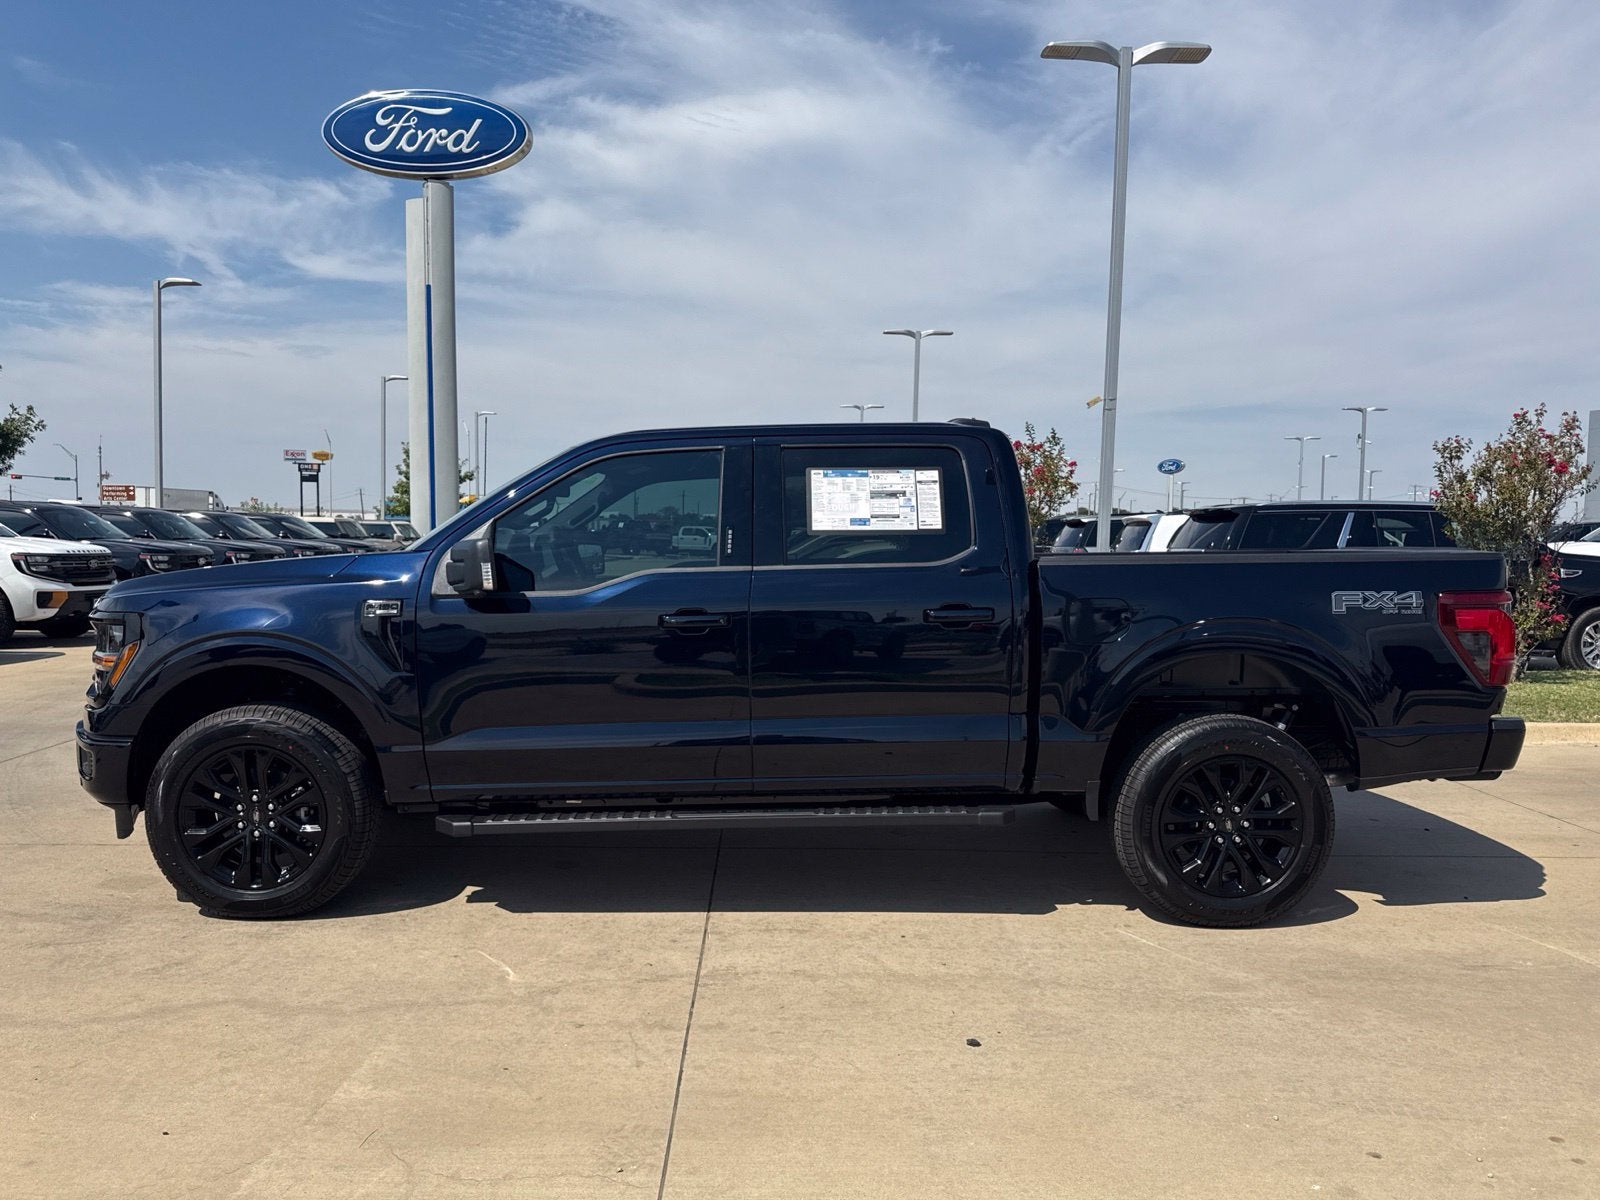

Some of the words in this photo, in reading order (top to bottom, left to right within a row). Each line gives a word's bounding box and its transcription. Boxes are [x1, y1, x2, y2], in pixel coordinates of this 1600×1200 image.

[364, 104, 483, 153] Ford
[285, 450, 305, 458] Exxon
[1331, 591, 1423, 614] FX4
